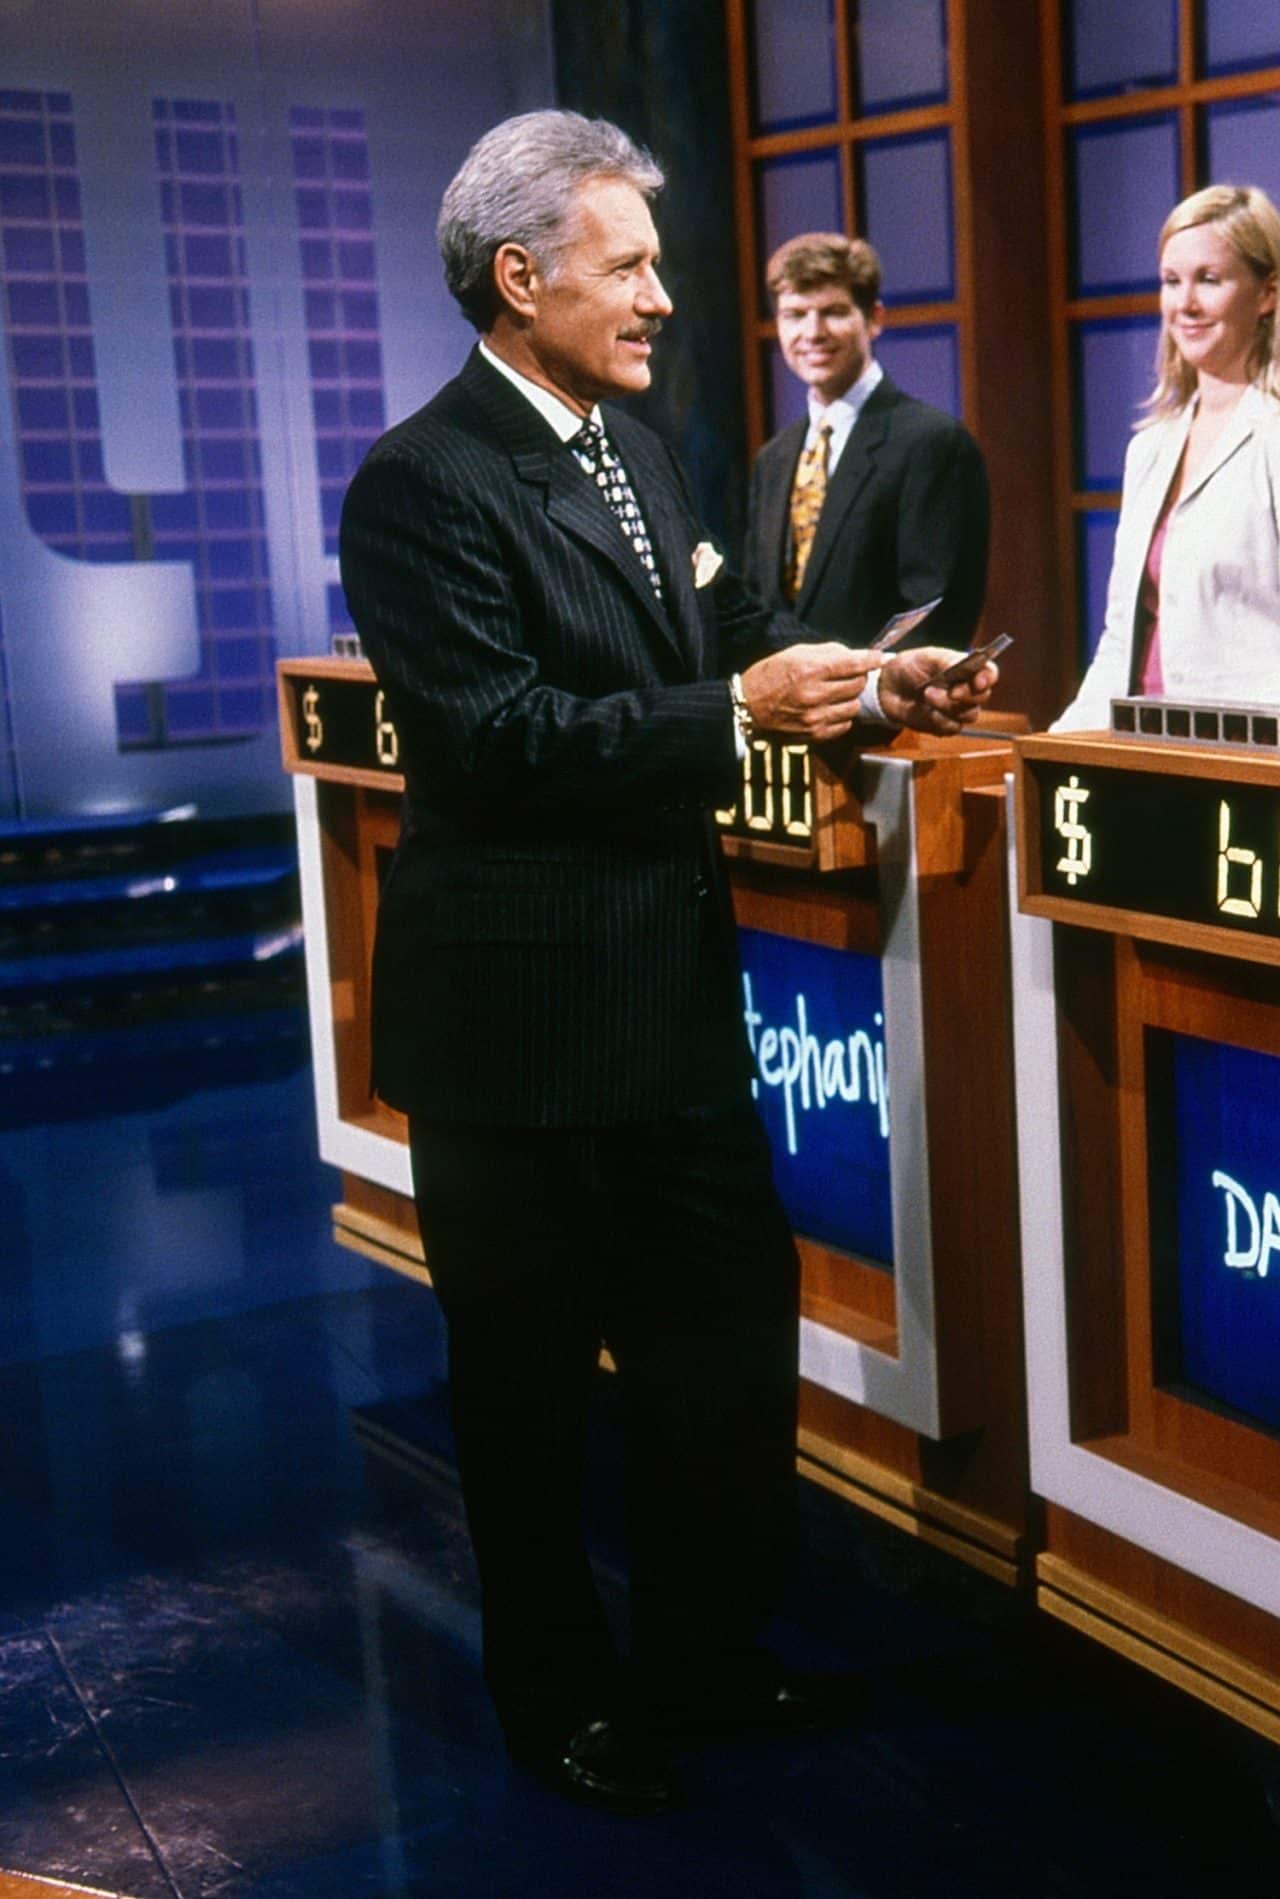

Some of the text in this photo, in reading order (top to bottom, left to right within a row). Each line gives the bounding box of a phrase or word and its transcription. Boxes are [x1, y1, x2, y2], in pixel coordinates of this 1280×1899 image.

[303, 685, 323, 752] $
[715, 740, 812, 837] 00
[1055, 775, 1092, 885] $
[743, 971, 889, 1155] tephani
